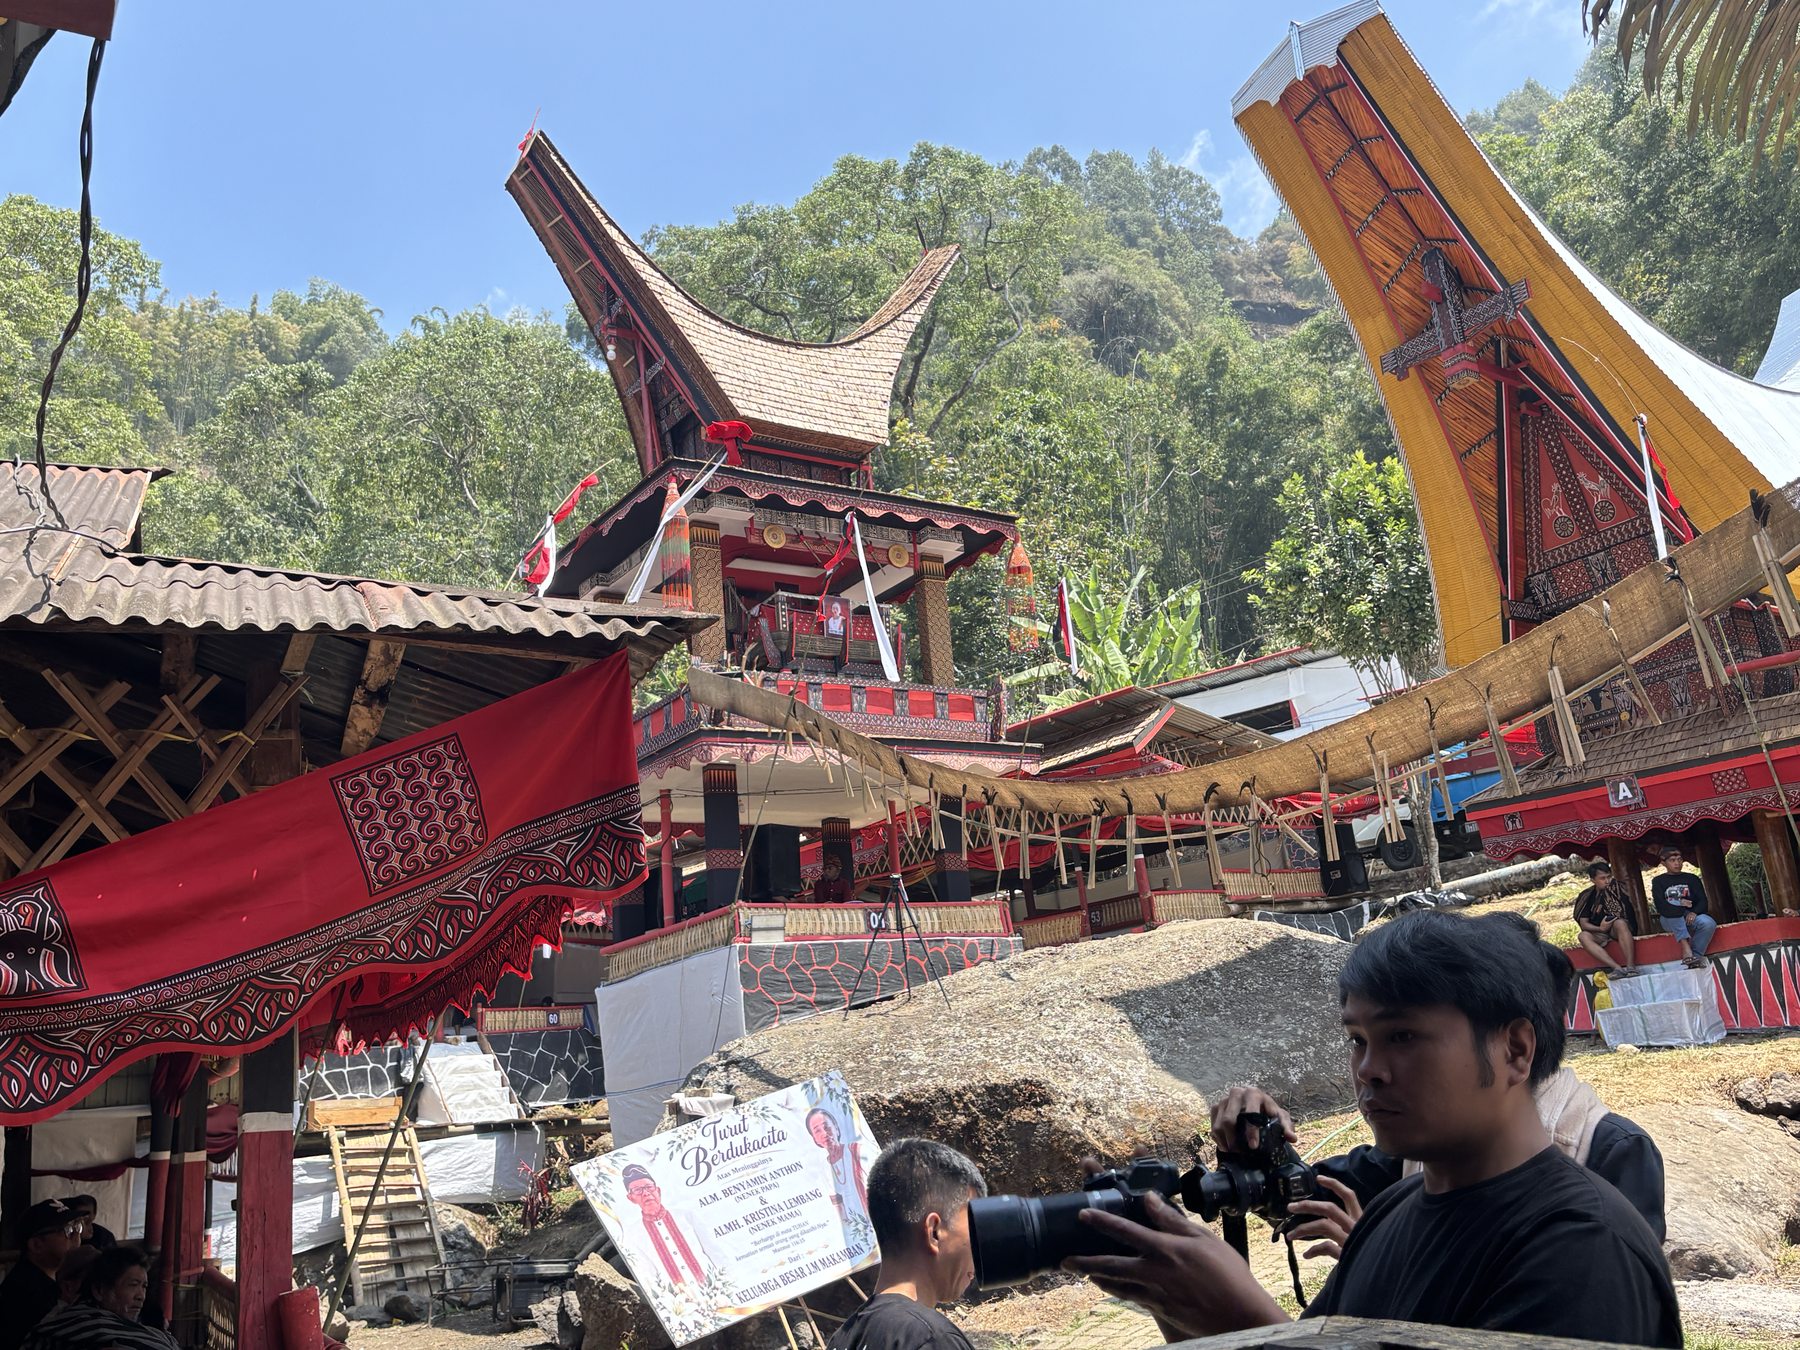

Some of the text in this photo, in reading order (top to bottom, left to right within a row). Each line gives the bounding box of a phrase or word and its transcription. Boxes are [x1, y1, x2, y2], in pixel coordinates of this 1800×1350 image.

[1618, 782, 1633, 800] A
[1091, 911, 1100, 923] 53
[549, 1013, 558, 1024] 60
[701, 1114, 749, 1151] Turut
[681, 1126, 787, 1187] Berdukacita
[717, 1157, 773, 1181] Atas Meninggalnya
[698, 1161, 804, 1208] ALM. BENYAMIN ANTHON
[734, 1181, 780, 1204] (NENEK PAPA)
[758, 1195, 769, 1206] &
[713, 1188, 823, 1238] ALMH. KRISTINA LEMBANG
[748, 1209, 802, 1235] (NENEK MAMA)
[787, 1253, 801, 1264] Dari
[735, 1277, 782, 1304] KELUARGA
[779, 1266, 808, 1286] BESAR
[818, 1242, 865, 1270] MAKAMBAN
